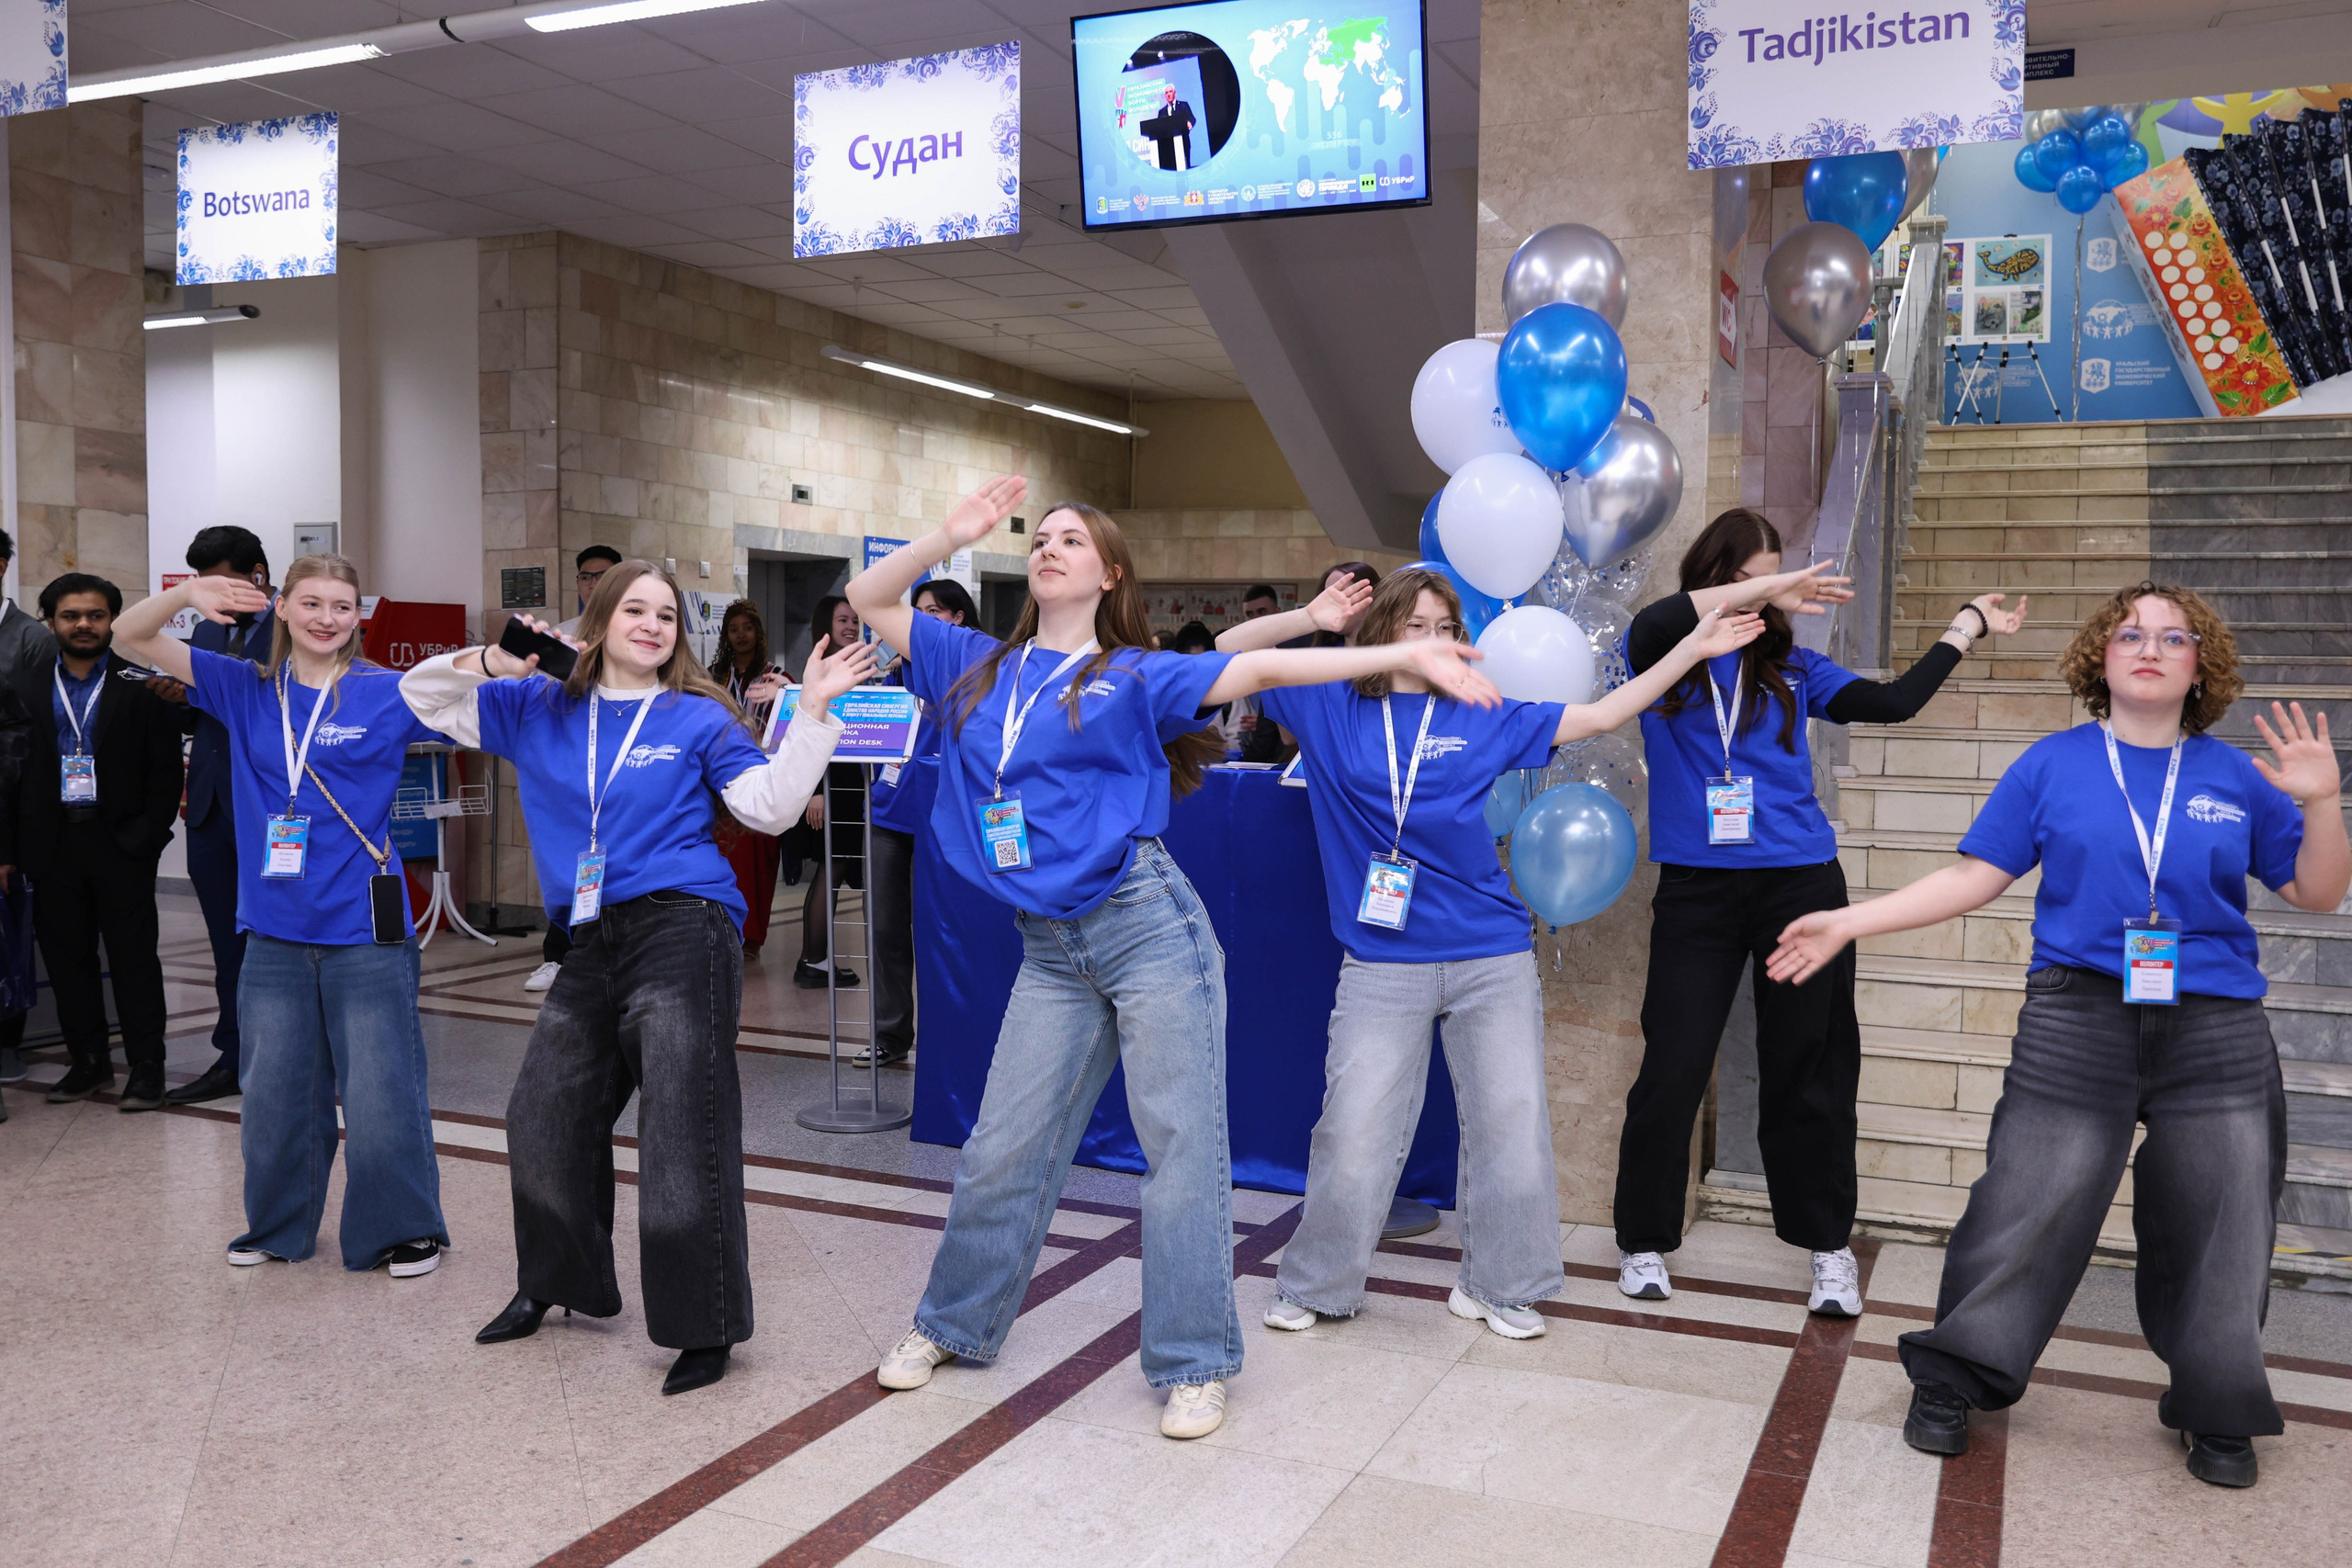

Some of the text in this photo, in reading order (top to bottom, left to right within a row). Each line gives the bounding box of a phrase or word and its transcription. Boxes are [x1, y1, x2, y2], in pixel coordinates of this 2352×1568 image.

[1738, 11, 1970, 66] Tadjikistan
[848, 130, 963, 180] Судан
[1391, 175, 1415, 185] УБРиР
[204, 189, 310, 218] Botswana
[419, 643, 459, 656] УБРиР
[2141, 938, 2154, 946] XVI
